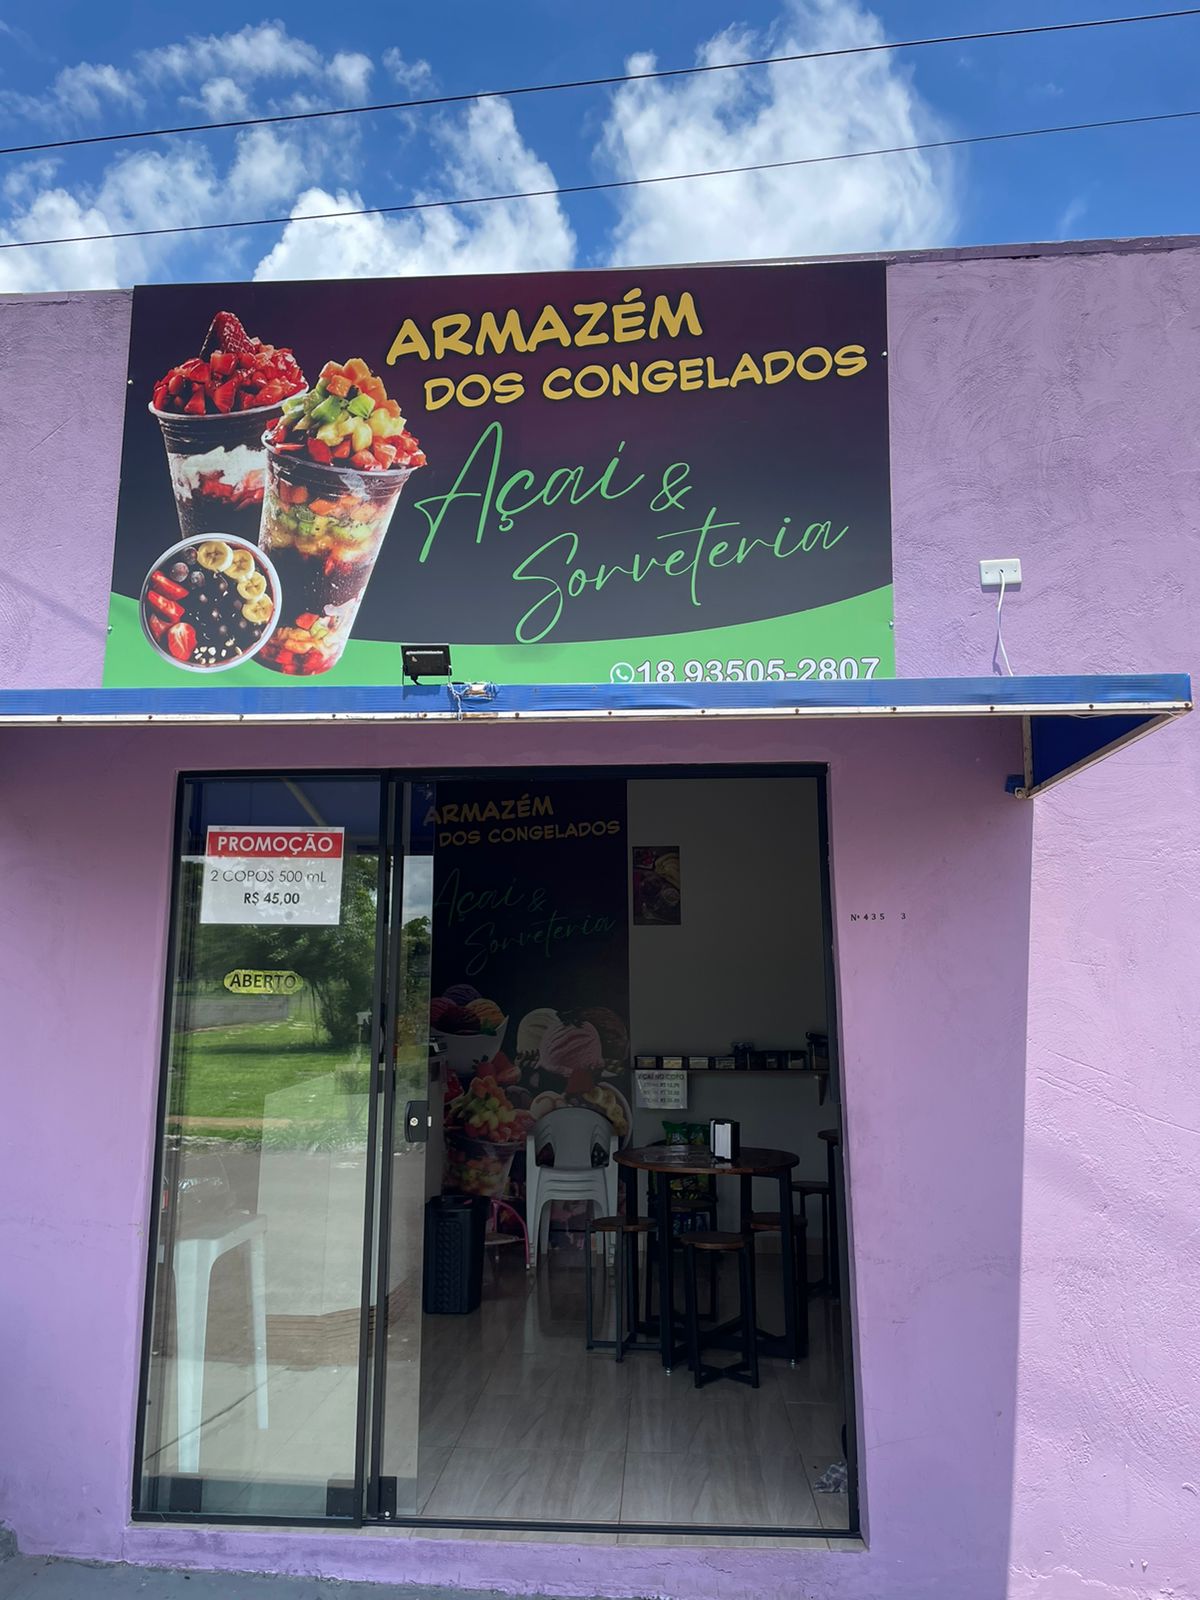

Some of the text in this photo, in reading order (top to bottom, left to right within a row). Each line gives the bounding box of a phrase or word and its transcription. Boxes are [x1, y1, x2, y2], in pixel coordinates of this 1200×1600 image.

[386, 288, 702, 366] ARMAZÉM
[424, 344, 868, 411] DOS CONGELADOS
[650, 462, 693, 512] &
[512, 507, 849, 644] Sorveteria
[636, 657, 880, 683] 18 93505-2807
[423, 793, 554, 826] ARMAZÉM
[217, 834, 333, 855] PROMOÇÃO
[439, 820, 620, 847] DOS CONGELADOS
[210, 869, 327, 883] 2 COPOS 500 mL
[243, 892, 300, 906] R$ 45,00
[464, 910, 617, 976] Sorveteria
[229, 973, 297, 989] ABERTO
